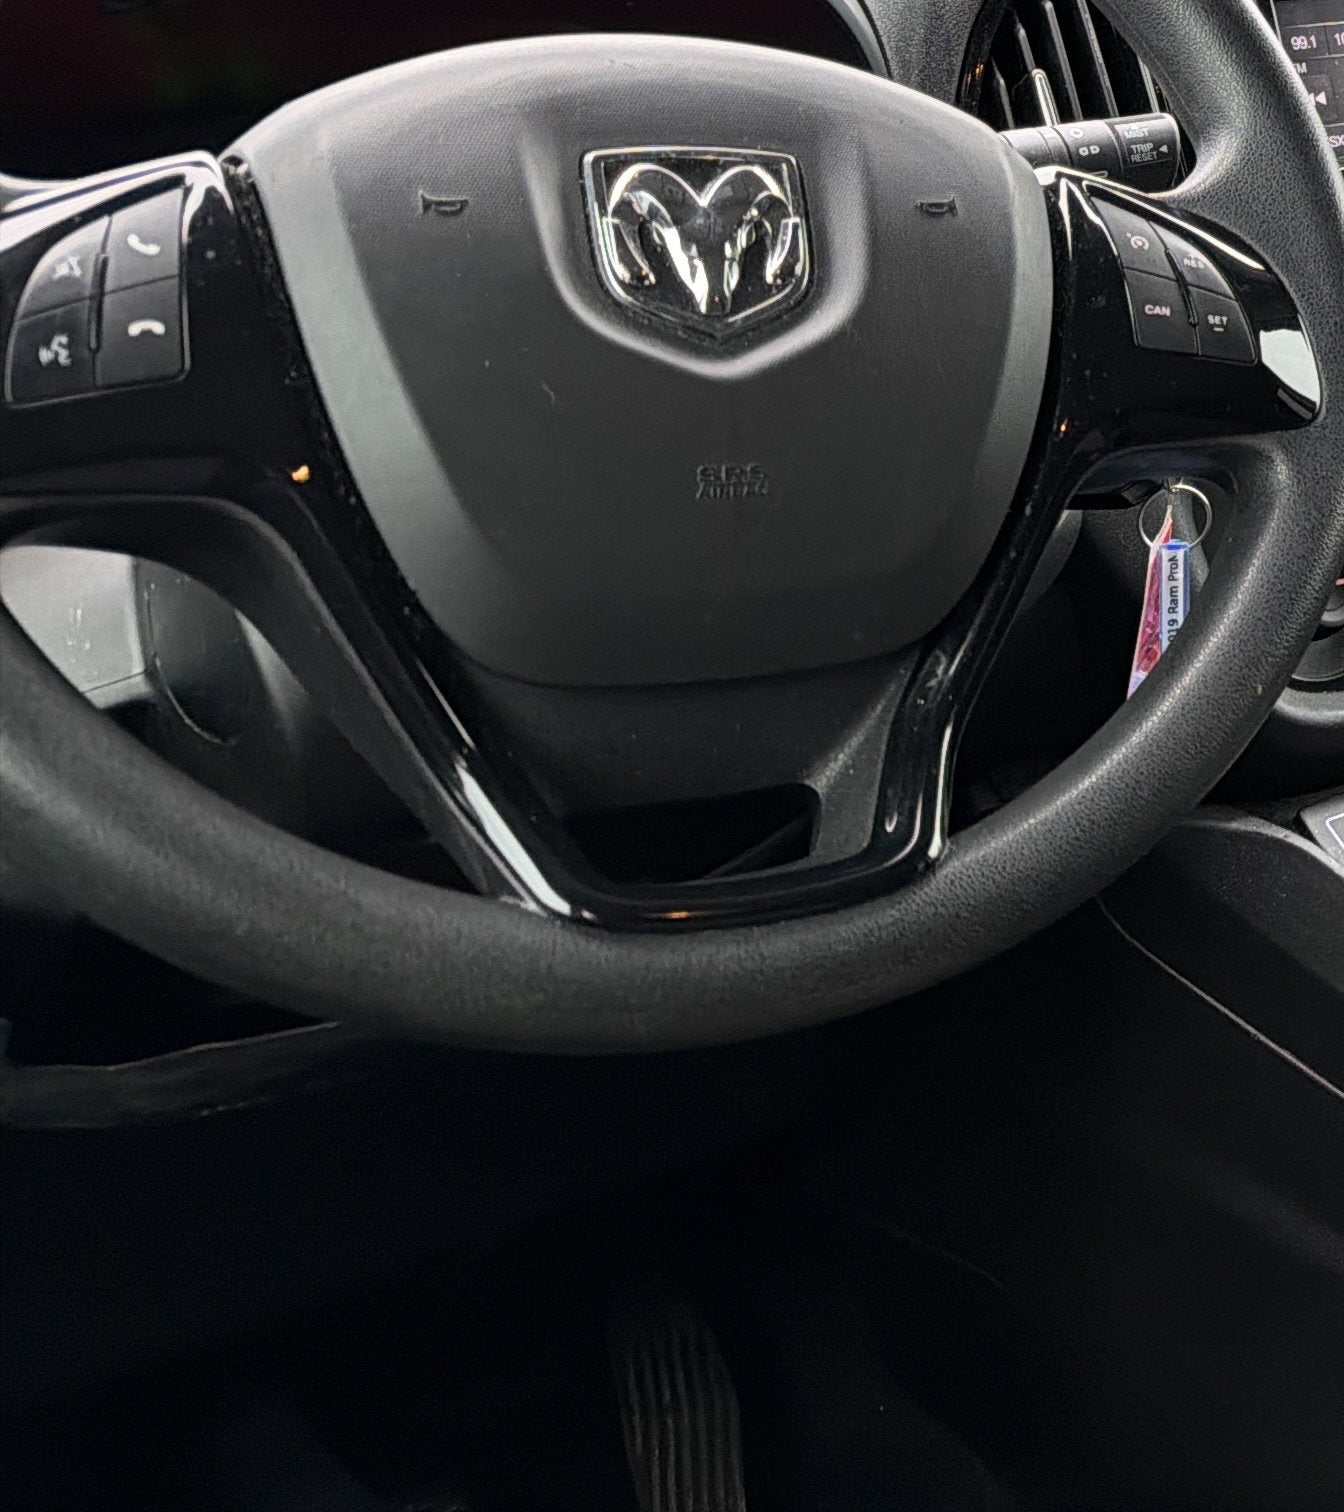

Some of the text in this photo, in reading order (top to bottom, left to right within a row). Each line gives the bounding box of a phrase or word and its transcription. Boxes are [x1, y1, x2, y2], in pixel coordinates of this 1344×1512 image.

[1291, 35, 1317, 50] 99.1
[1130, 142, 1154, 154] TRIP
[1131, 150, 1158, 163] RESET
[1144, 304, 1171, 317] CAN
[1207, 314, 1229, 326] SET
[1167, 585, 1179, 615] Ram
